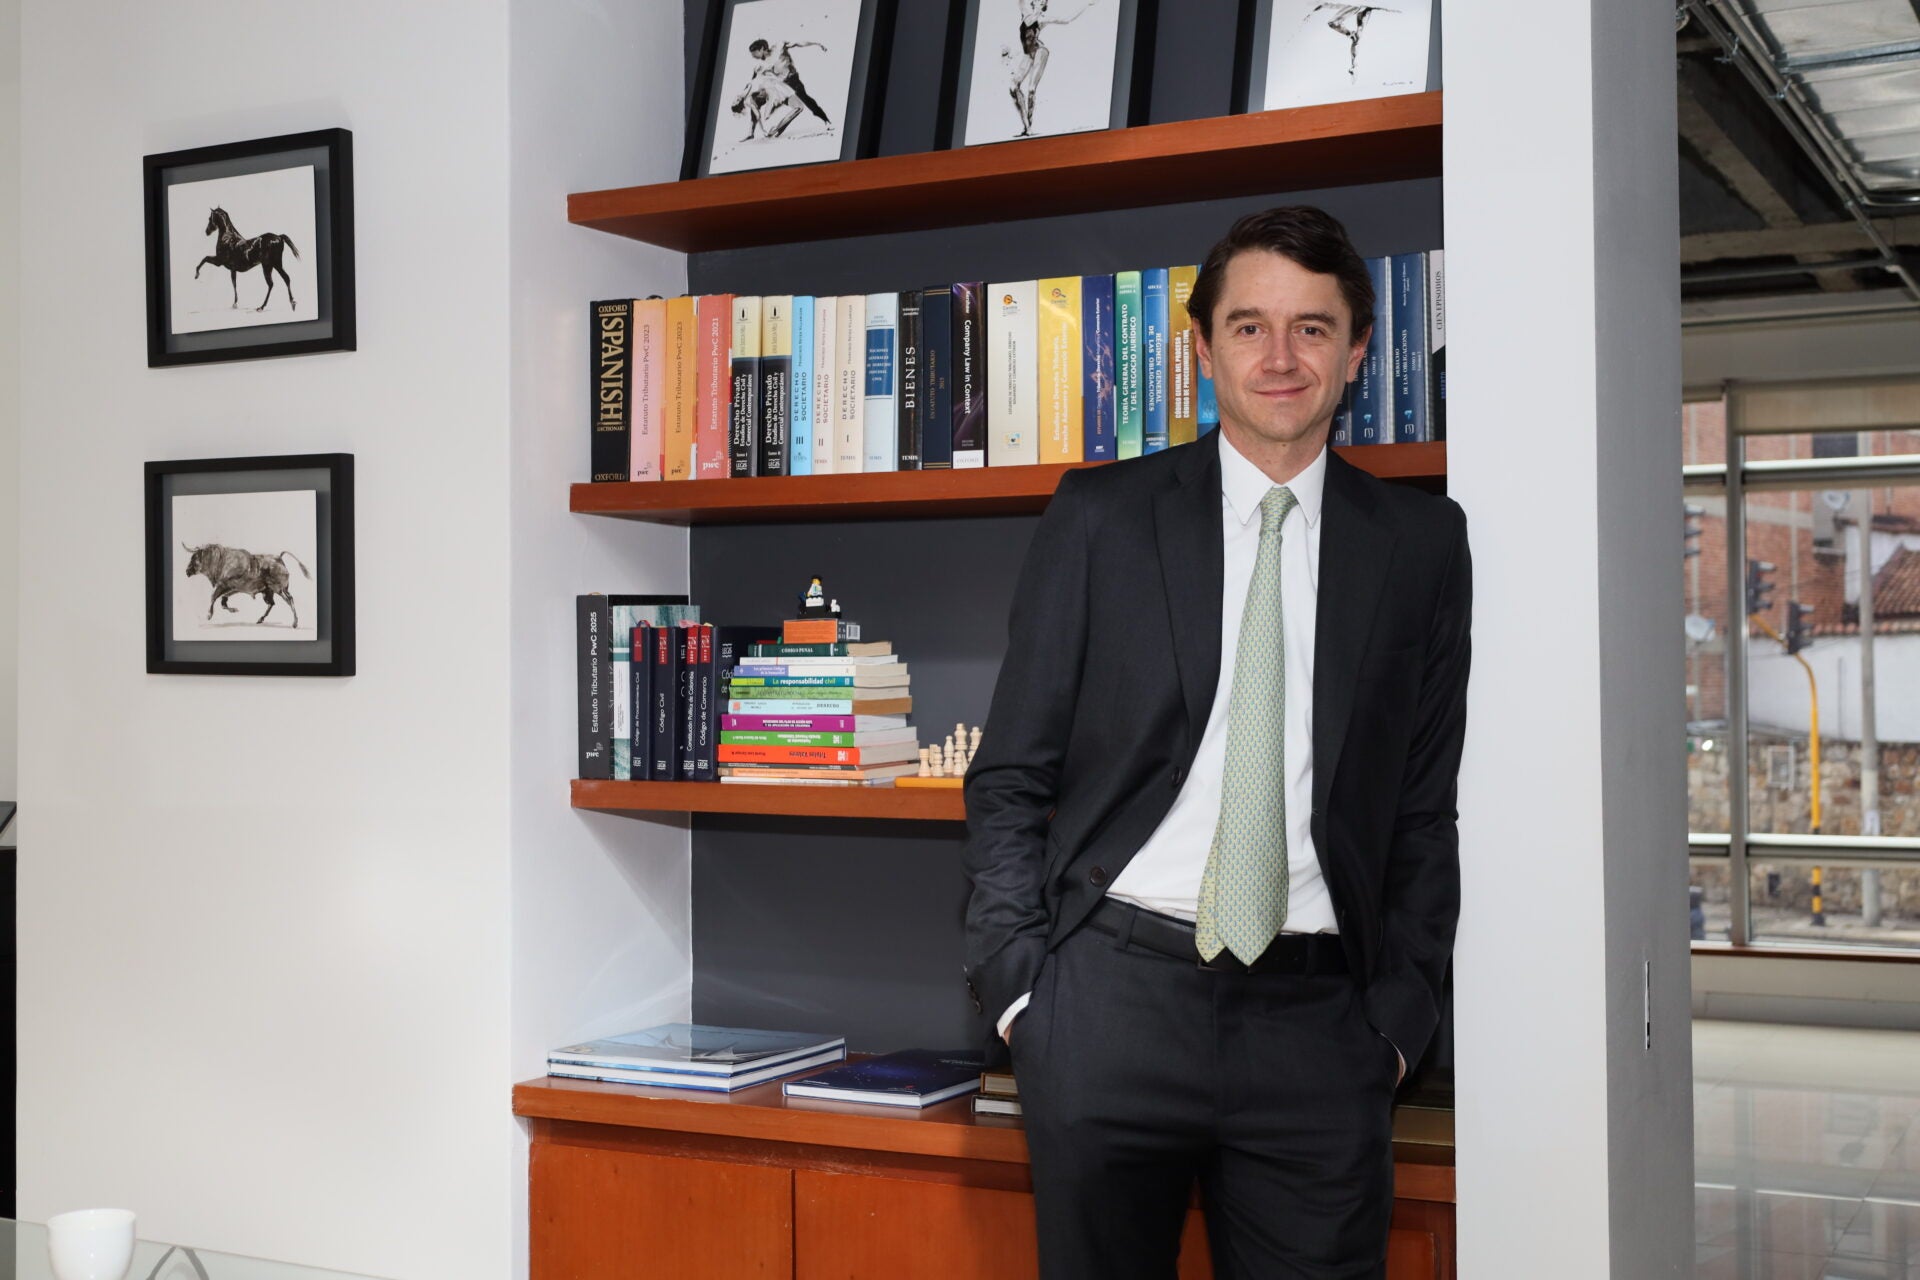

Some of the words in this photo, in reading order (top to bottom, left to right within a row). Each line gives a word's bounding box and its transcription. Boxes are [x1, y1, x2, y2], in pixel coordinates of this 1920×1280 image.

[599, 304, 628, 313] OXFORD
[643, 324, 651, 344] 2023
[711, 317, 719, 337] 2021
[1121, 304, 1129, 345] CONTRATO
[1129, 316, 1137, 352] JURÍDICO
[1148, 325, 1155, 336] DE
[711, 338, 719, 357] PwC
[963, 319, 972, 357] Company
[600, 317, 625, 421] SPANISH
[964, 357, 972, 374] Law
[642, 363, 650, 403] Tributario
[905, 345, 916, 409] BIENES
[964, 374, 972, 383] in
[1155, 369, 1163, 403] GENERAL
[964, 383, 972, 414] Context
[1363, 389, 1369, 399] DE
[1403, 385, 1408, 395] DE
[641, 403, 649, 436] Estatuto
[710, 397, 718, 430] Estatuto
[1120, 397, 1128, 425] TEORÍA
[733, 409, 741, 445] Derecho
[795, 436, 804, 445] III
[818, 438, 824, 446] II
[637, 469, 649, 477] pwc
[671, 467, 683, 476] pwc
[702, 462, 720, 470] pwc
[595, 473, 625, 482] OXFORD
[590, 635, 598, 656] PwC
[700, 676, 708, 710] Comercio
[700, 711, 706, 721] de
[686, 721, 694, 752] Constitución
[586, 750, 599, 758] pwc
